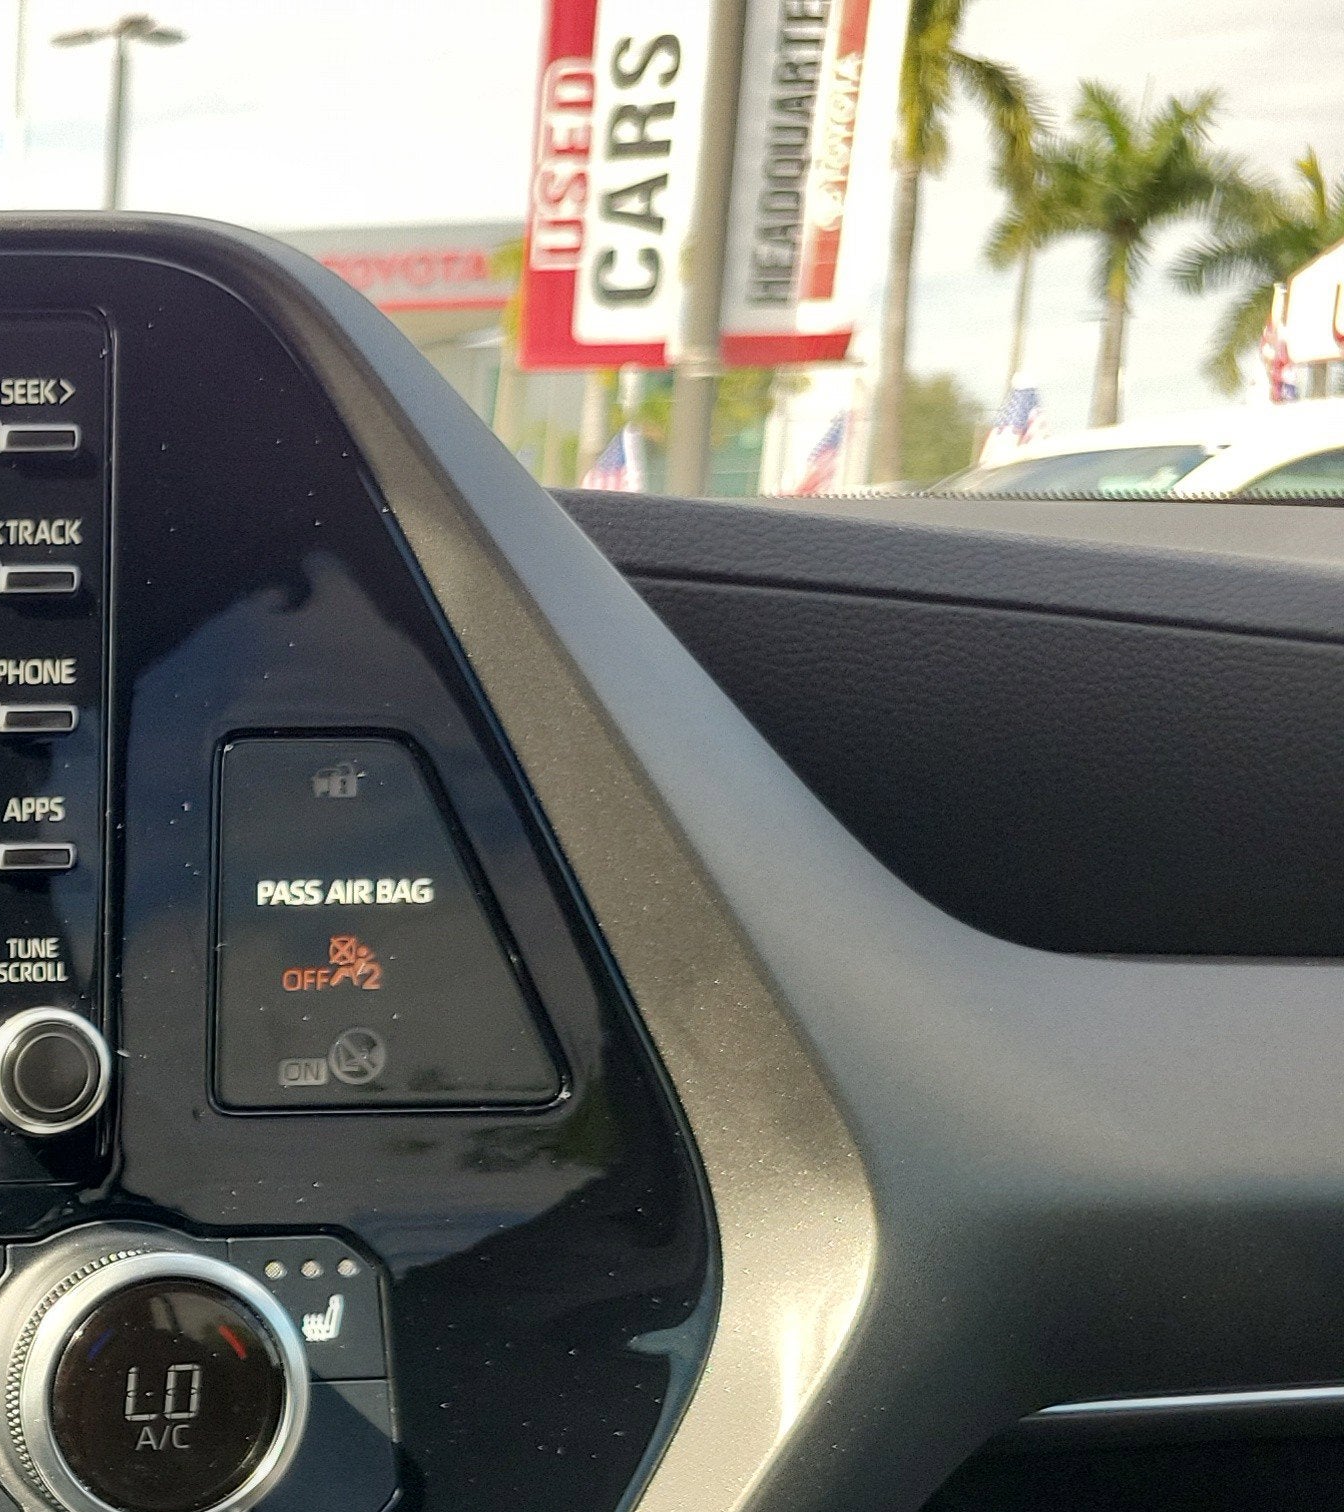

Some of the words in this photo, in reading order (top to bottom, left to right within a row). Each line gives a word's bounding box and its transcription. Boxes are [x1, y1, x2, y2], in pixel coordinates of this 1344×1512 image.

[538, 67, 595, 256] USED
[595, 33, 682, 309] CARS
[3, 797, 66, 823] APPS
[257, 880, 323, 906] PASS
[324, 879, 375, 905] AIR
[376, 878, 435, 904] BAG
[6, 938, 60, 959] TUNE
[281, 967, 330, 992] OFF
[282, 1060, 323, 1083] ON
[134, 1424, 192, 1452] A/C
